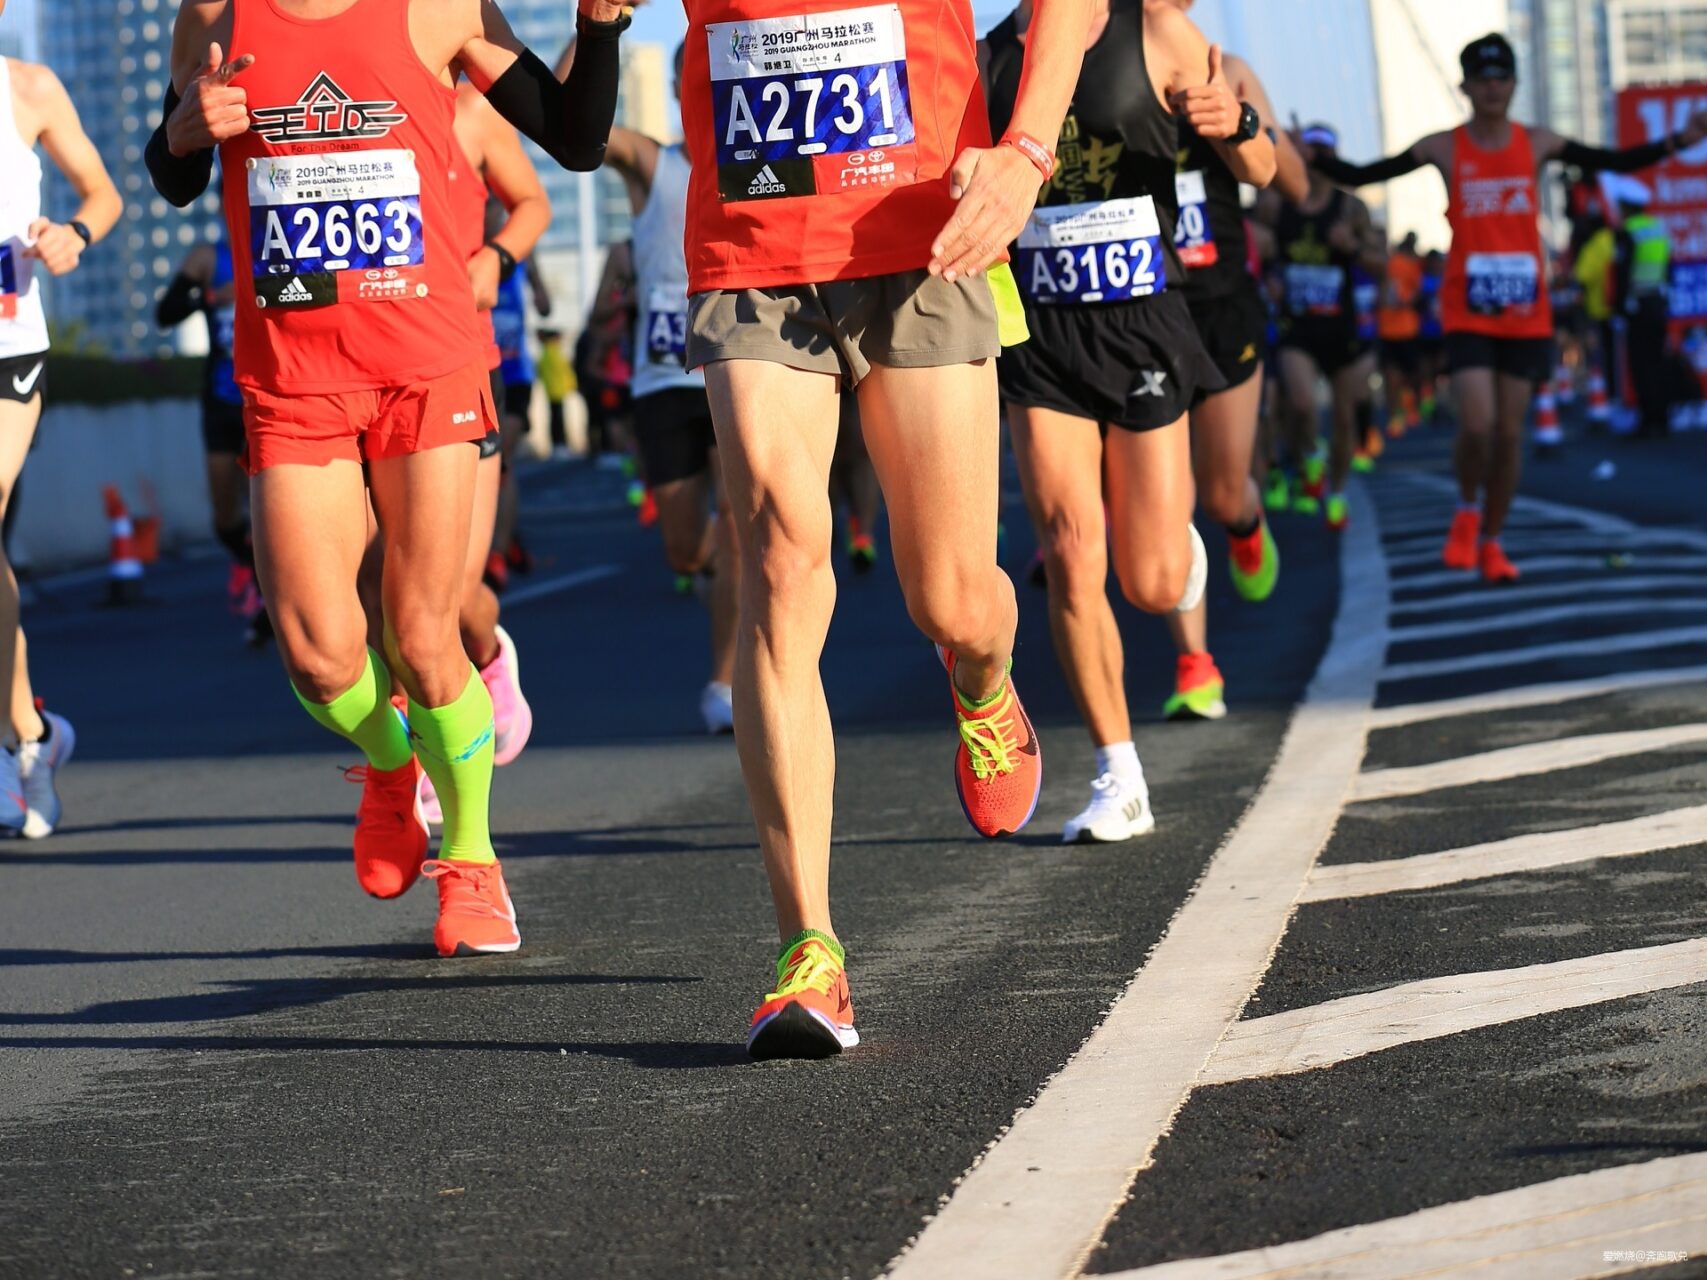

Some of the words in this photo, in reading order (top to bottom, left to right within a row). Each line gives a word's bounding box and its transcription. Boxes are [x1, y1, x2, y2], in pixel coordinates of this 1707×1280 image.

[761, 22, 875, 47] 2019广州马拉松赛
[764, 48, 779, 56] 2019
[780, 42, 830, 55] GUANGZHOU
[830, 36, 877, 48] MARATHON
[834, 53, 842, 64] 4
[725, 68, 895, 146] A2731
[290, 145, 307, 153] For
[332, 142, 360, 151] Dream
[312, 177, 355, 186] GUANGZHOU
[356, 173, 395, 183] MARATHON
[747, 182, 786, 196] adidas
[261, 200, 412, 261] A2663
[1031, 239, 1156, 293] A3162
[278, 290, 313, 303] adidas
